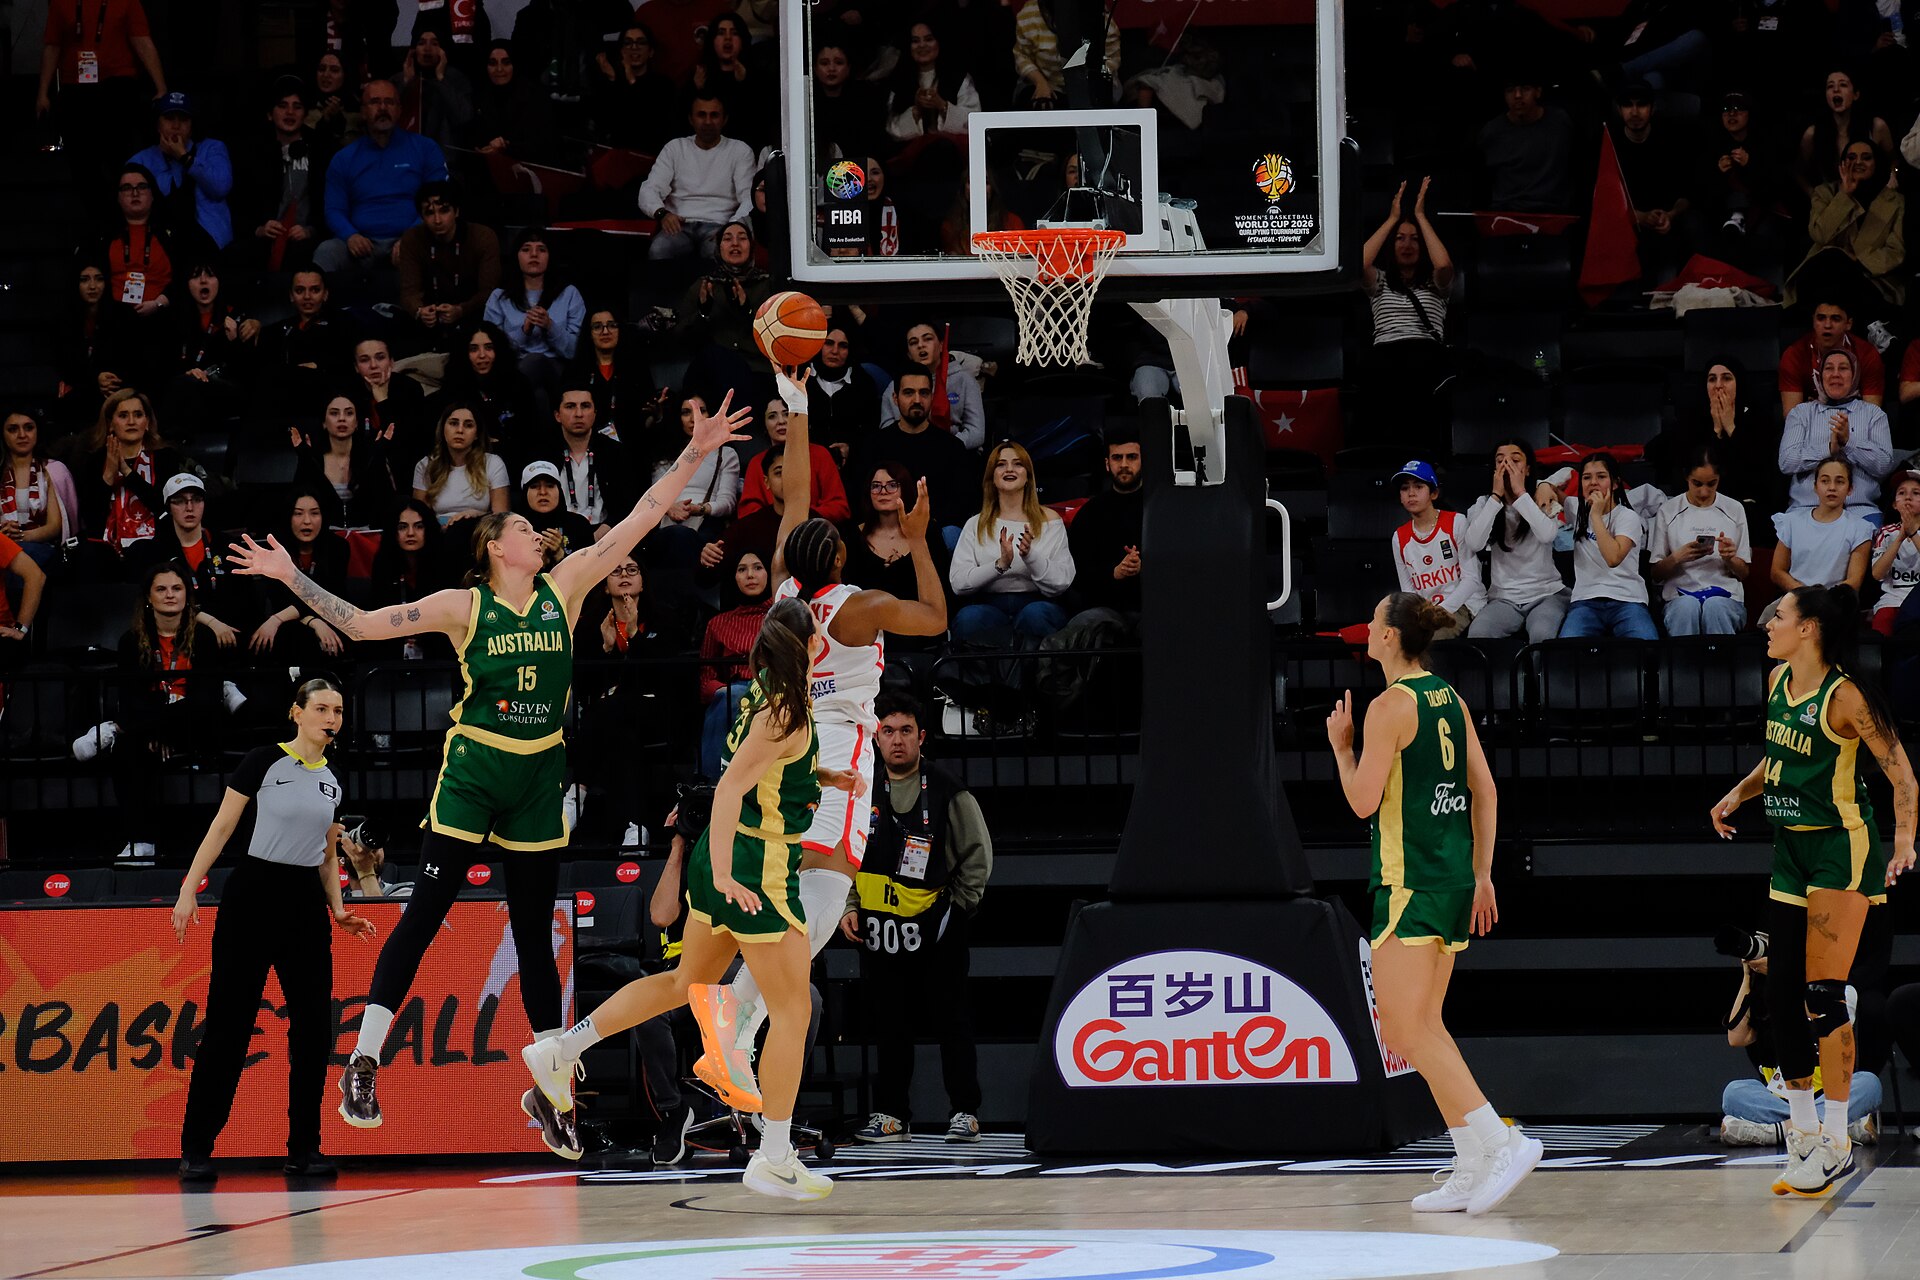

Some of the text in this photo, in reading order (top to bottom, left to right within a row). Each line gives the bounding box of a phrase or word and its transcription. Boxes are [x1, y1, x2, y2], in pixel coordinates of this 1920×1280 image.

[830, 209, 862, 225] FIBA
[1235, 220, 1314, 228] WORLD CUP 2026
[1238, 228, 1270, 236] QUALIFYING
[1411, 562, 1461, 591] ÜRKİYE
[1892, 566, 1920, 582] bek
[487, 630, 563, 657] AUSTRALIA
[516, 665, 537, 692] 15
[1423, 687, 1453, 708] TALBOT
[509, 700, 552, 715] SEVEN
[497, 713, 548, 724] CONSULTING
[1437, 717, 1456, 772] 6
[54, 881, 70, 889] TBF
[578, 899, 593, 907] TBF
[865, 916, 922, 954] 308
[1107, 972, 1271, 1018] 百岁山
[1072, 1016, 1331, 1082] Ganten
